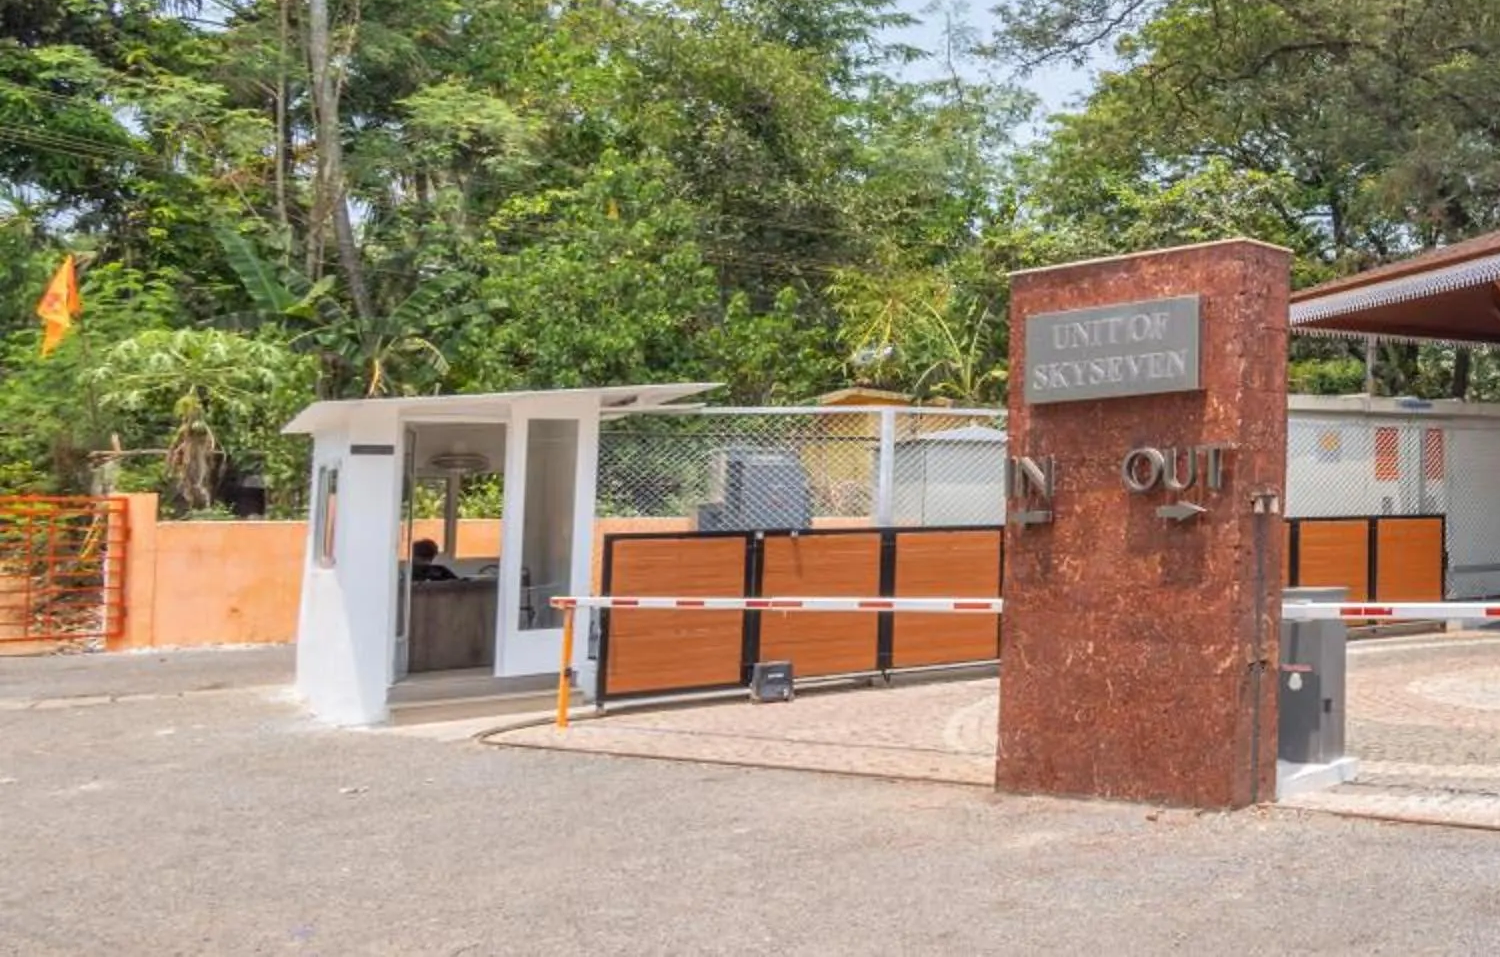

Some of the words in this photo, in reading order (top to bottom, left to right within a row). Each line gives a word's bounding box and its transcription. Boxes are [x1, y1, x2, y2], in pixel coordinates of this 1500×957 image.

[1053, 317, 1124, 349] UNIT
[1130, 312, 1170, 342] OF
[1033, 349, 1188, 390] SKYSEVEN
[1005, 454, 1055, 499] IN
[1122, 444, 1236, 491] OUT
